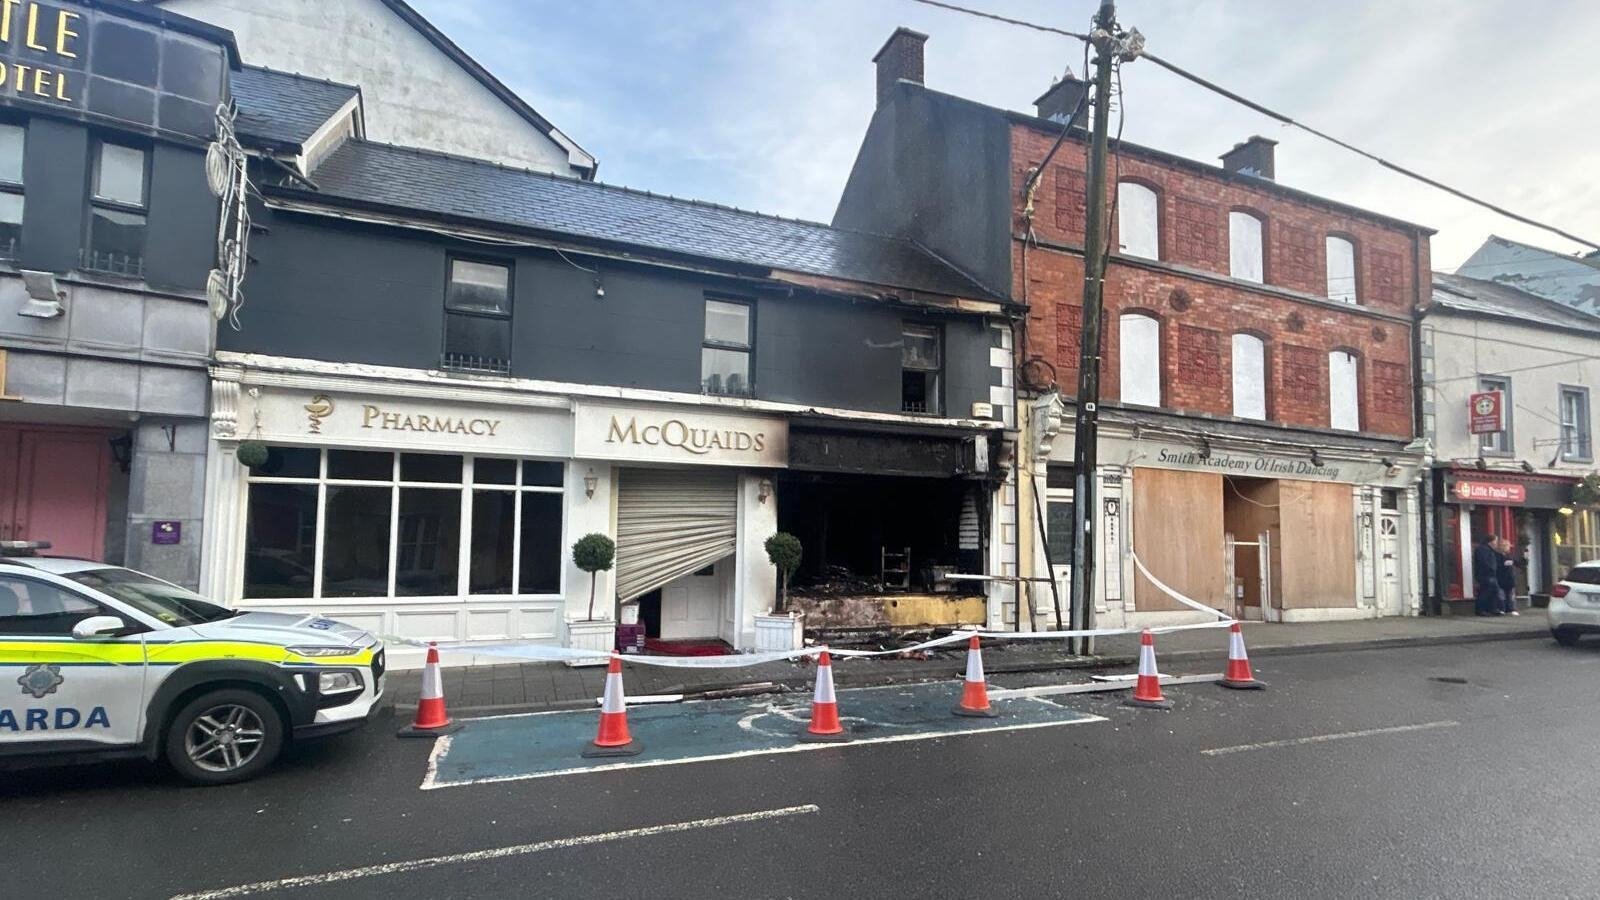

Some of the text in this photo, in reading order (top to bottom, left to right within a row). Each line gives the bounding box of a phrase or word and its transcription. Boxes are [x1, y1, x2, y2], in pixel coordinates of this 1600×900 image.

[361, 405, 501, 437] PHARMACY
[1158, 448, 1195, 465] Smith
[1254, 457, 1272, 471] Of
[1272, 459, 1295, 474] Irish
[1296, 461, 1340, 479] Dancing
